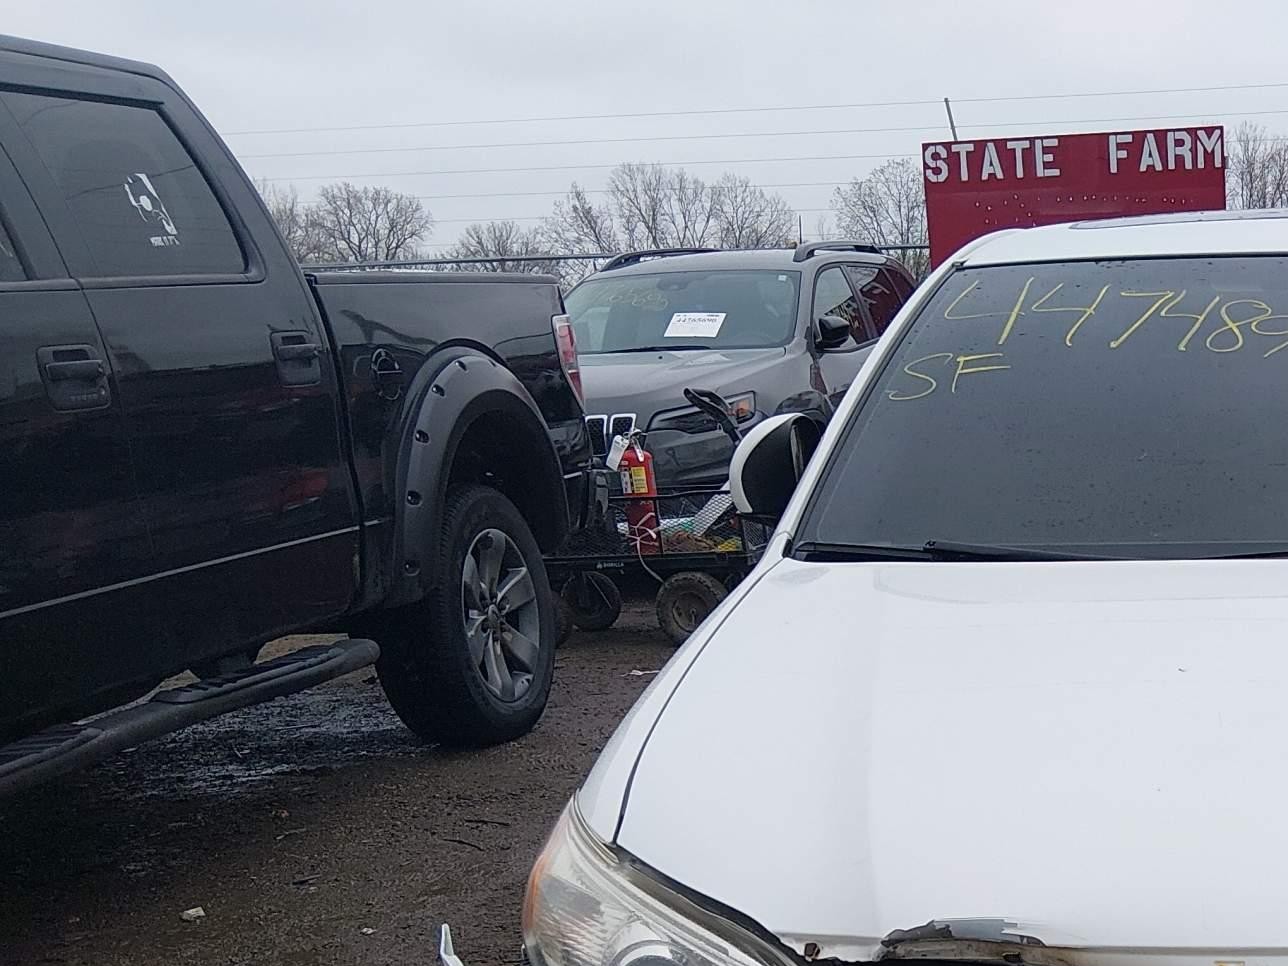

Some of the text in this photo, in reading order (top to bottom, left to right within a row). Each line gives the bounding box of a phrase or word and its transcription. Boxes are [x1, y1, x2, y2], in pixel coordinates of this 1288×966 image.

[924, 129, 1224, 183] STATE FARM
[889, 353, 1011, 401] SF
